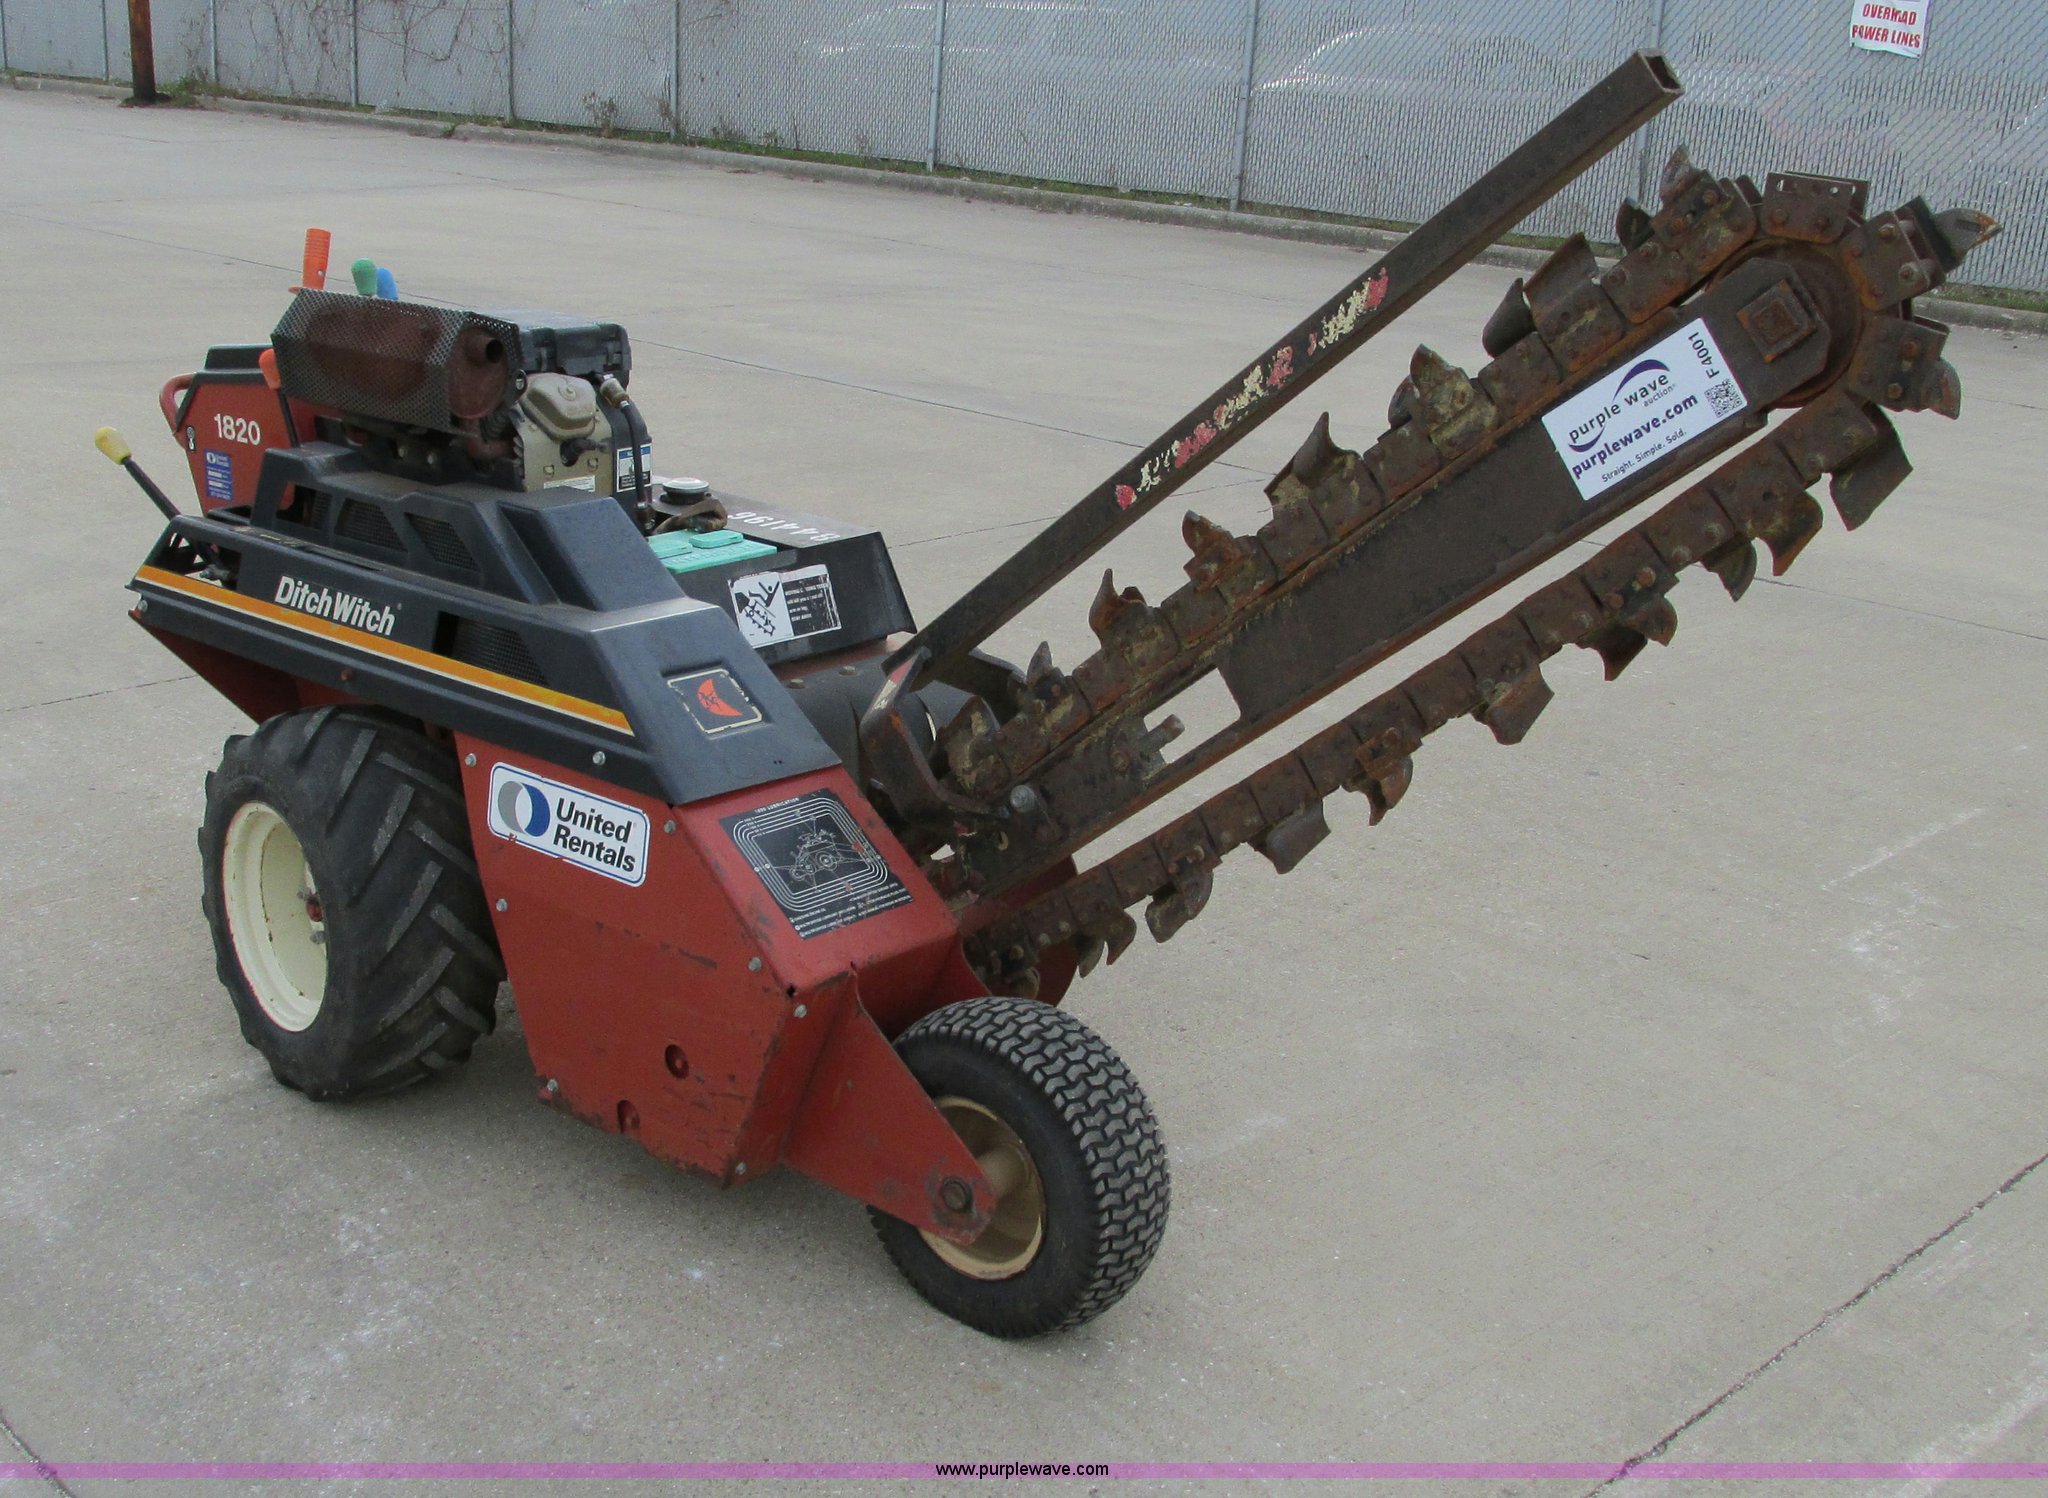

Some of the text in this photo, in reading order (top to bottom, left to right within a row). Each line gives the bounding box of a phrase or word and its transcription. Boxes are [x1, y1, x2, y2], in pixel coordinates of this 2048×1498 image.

[1852, 24, 1888, 42] POWER
[1688, 332, 1713, 366] 4001
[1568, 373, 1669, 444] purple wave
[1643, 385, 1674, 407] auction
[214, 413, 261, 446] 1820
[1572, 394, 1698, 480] purplewave.com
[1602, 429, 1687, 482] Straight. Simple. Sold.
[556, 798, 632, 843] United
[553, 824, 636, 872] Rentals
